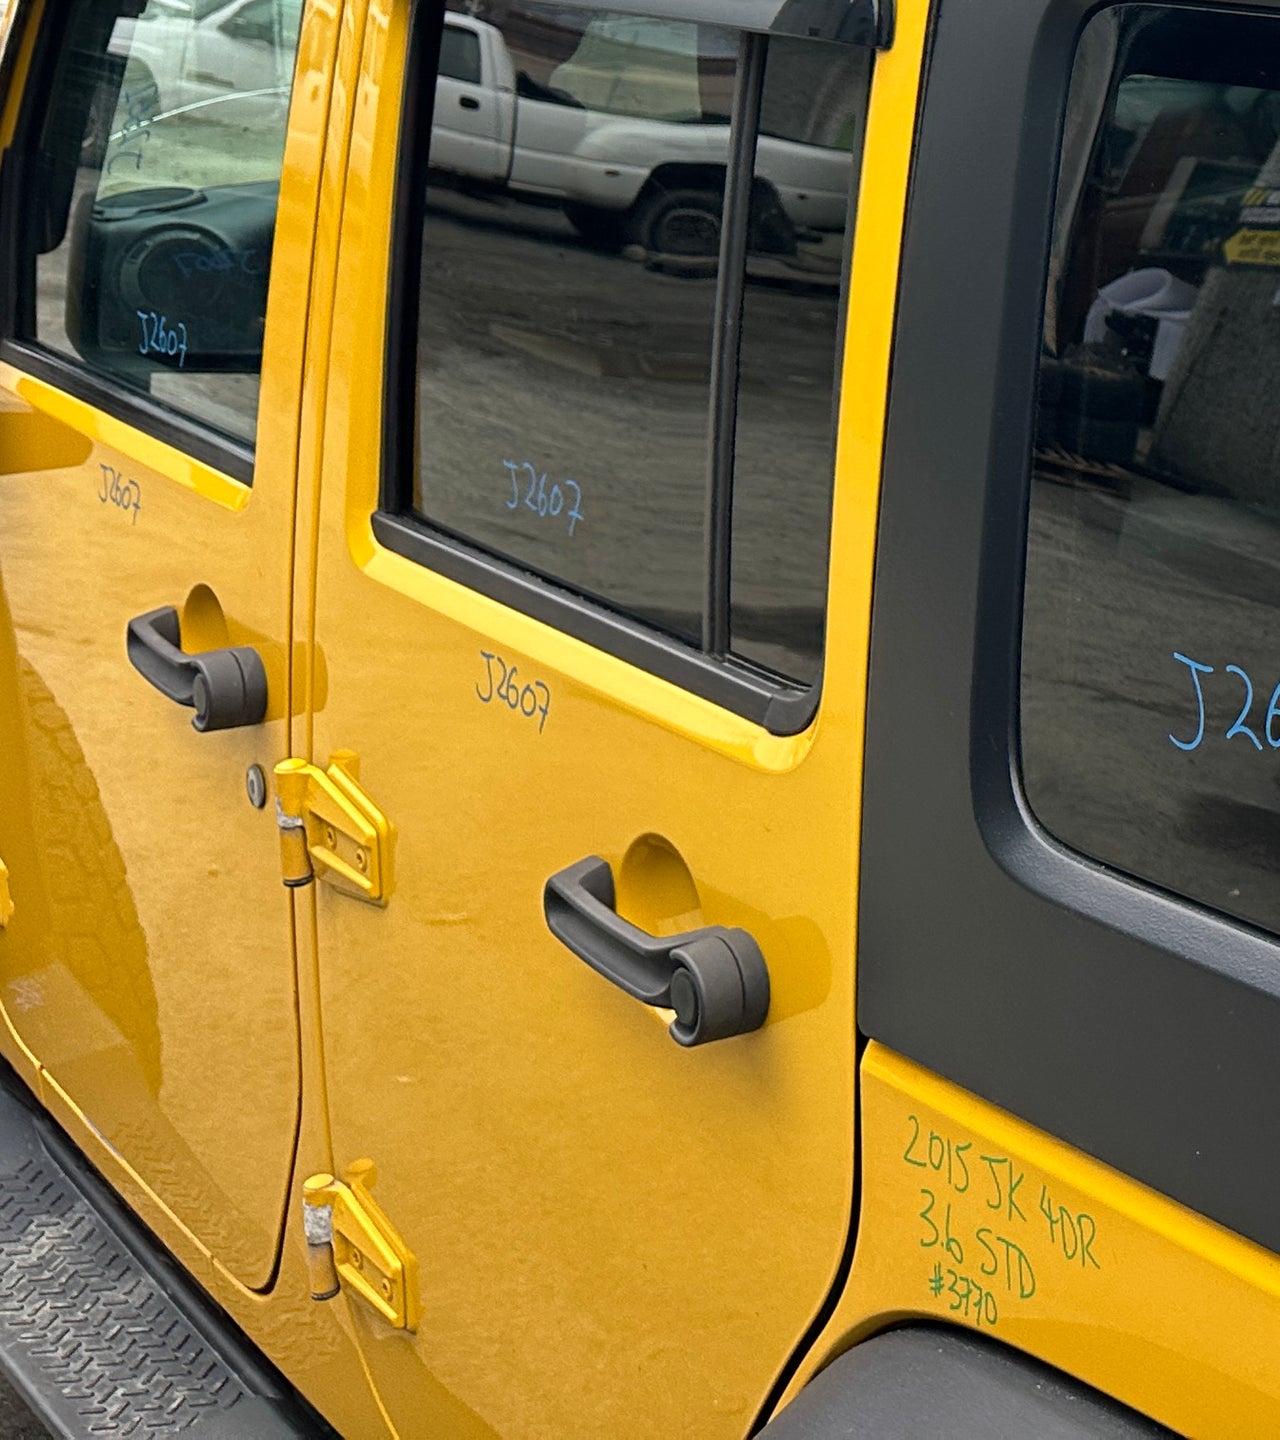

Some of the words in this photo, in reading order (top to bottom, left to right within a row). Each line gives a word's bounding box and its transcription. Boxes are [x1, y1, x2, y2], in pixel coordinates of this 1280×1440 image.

[137, 310, 188, 368] J2607
[99, 463, 142, 526] J2607
[503, 458, 585, 537] J2607
[475, 649, 552, 735] J2607
[903, 1115, 973, 1194] 2015
[980, 1155, 1027, 1223] JK
[1039, 1184, 1101, 1270] 4DR
[920, 1188, 964, 1264] 3.6
[976, 1227, 1036, 1300] STD
